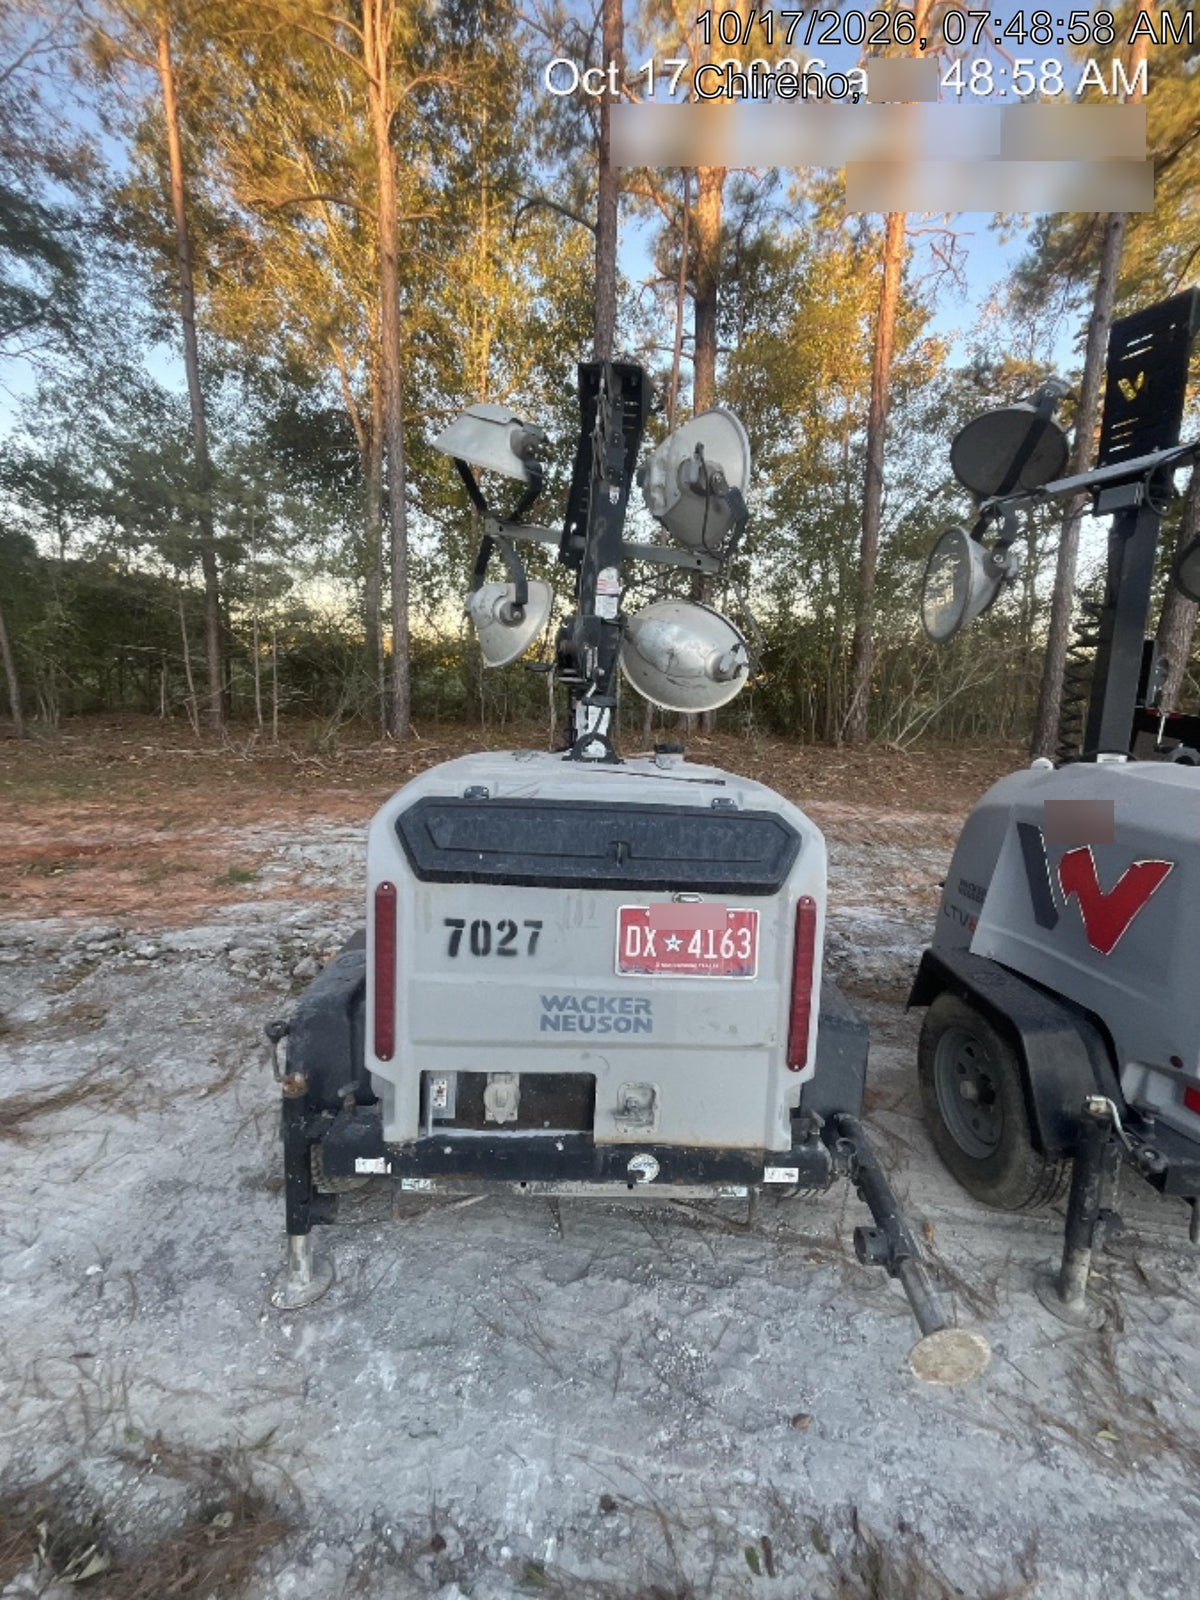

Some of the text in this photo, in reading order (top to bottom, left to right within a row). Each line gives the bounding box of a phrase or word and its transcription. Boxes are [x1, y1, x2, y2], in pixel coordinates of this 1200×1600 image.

[443, 917, 543, 957] 7027
[625, 925, 752, 960] DX 4163
[539, 995, 653, 1015] WACKER
[540, 1014, 653, 1034] NEUSON
